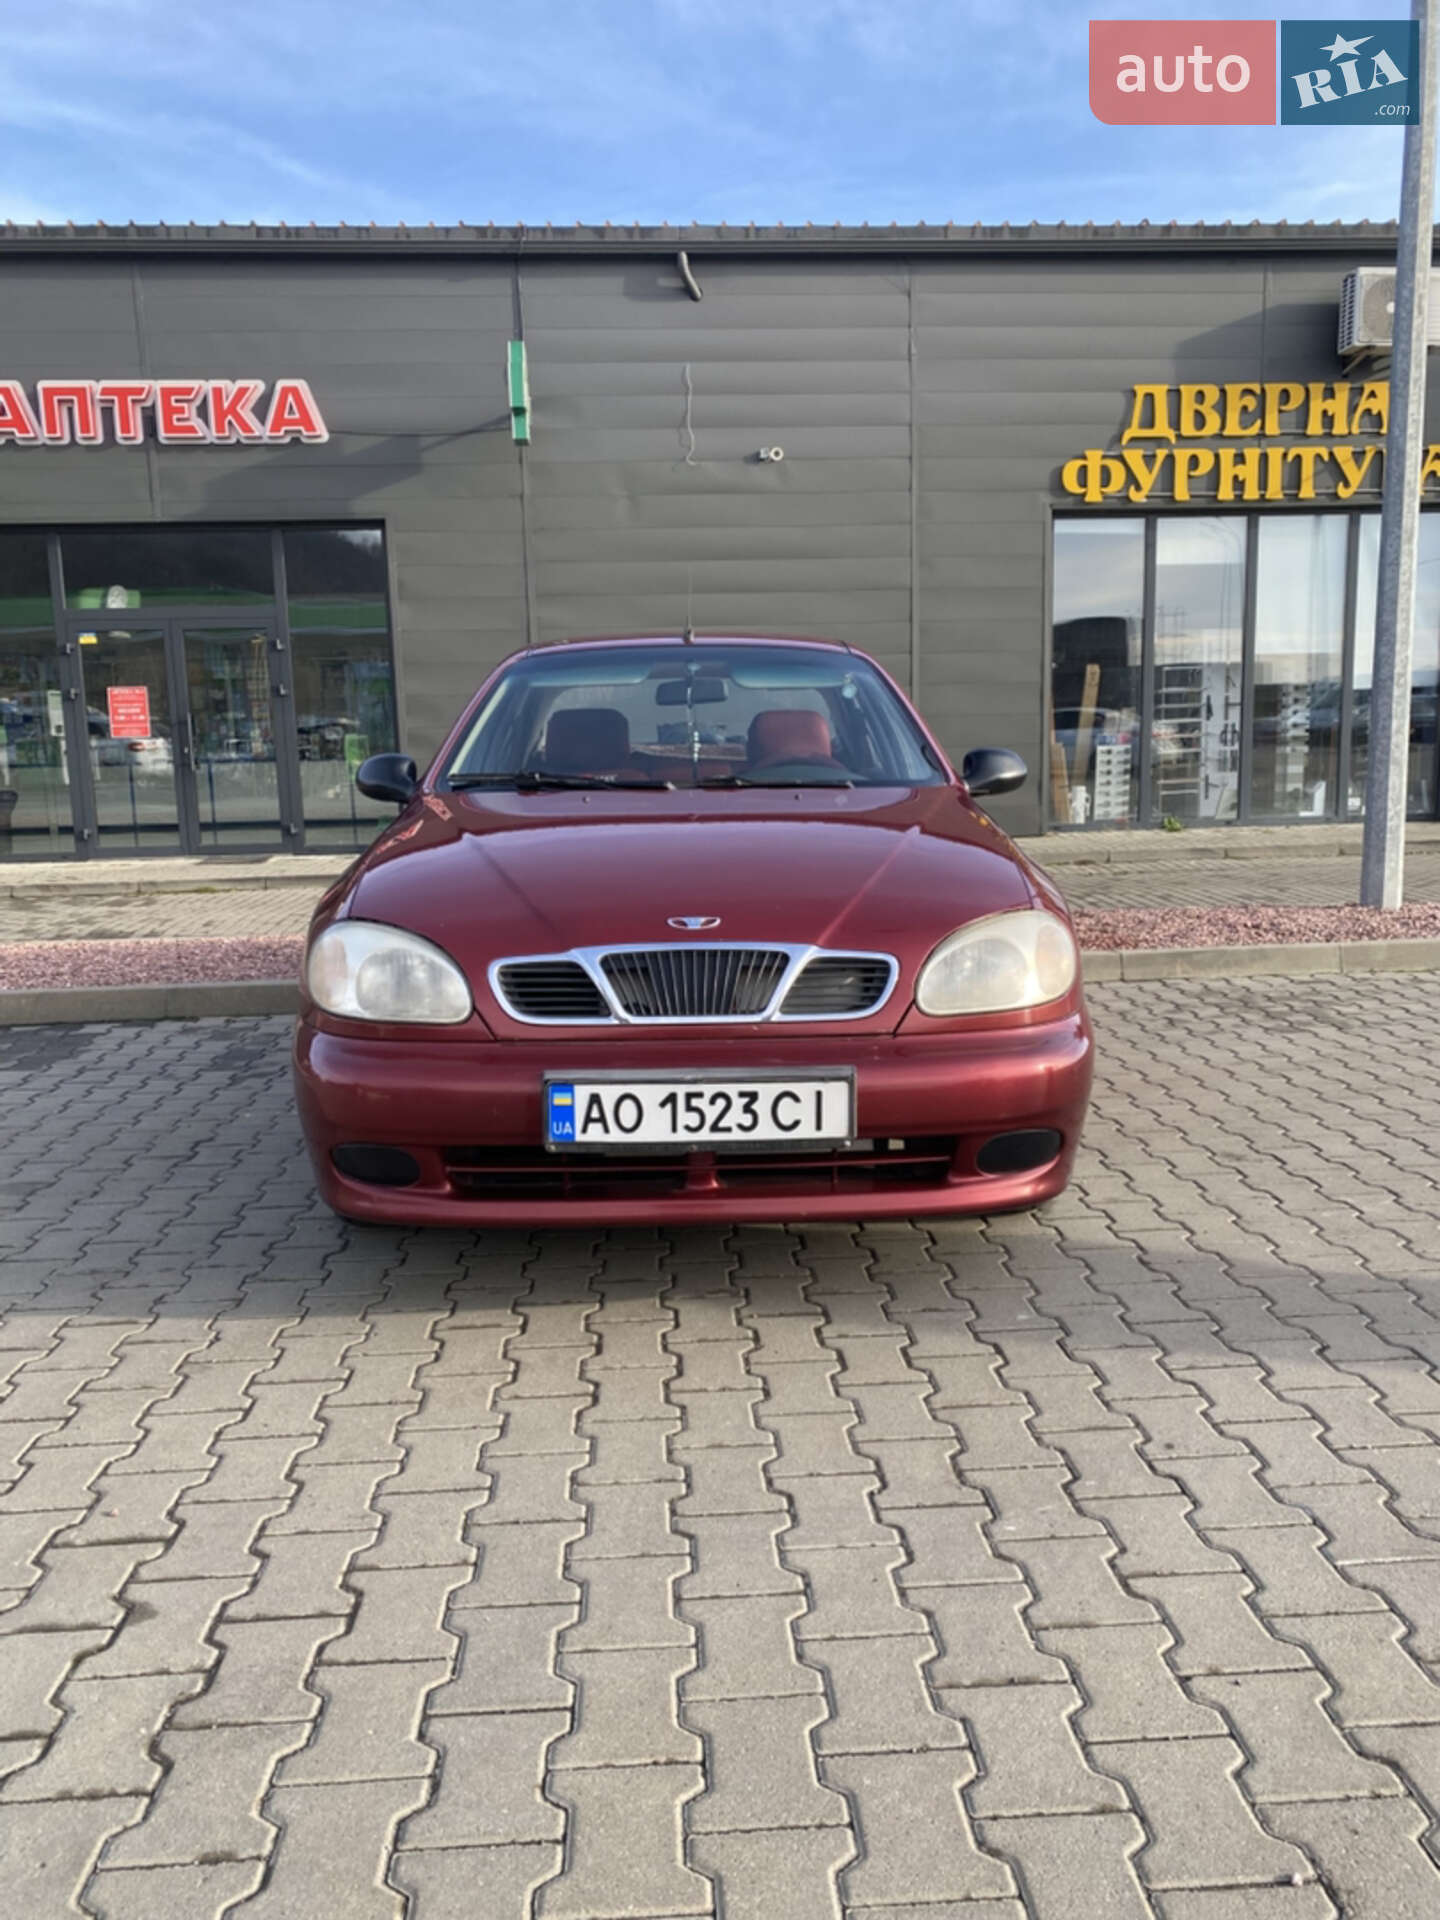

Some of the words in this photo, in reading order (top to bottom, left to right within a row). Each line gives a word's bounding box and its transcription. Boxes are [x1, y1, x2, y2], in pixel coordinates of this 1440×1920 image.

[0, 380, 329, 444] АПТЕКА
[1121, 381, 1390, 445] ДВЕРНА
[553, 1121, 573, 1136] UA
[580, 1092, 644, 1134] AO
[658, 1090, 759, 1134] 1523
[771, 1090, 823, 1132] CI
